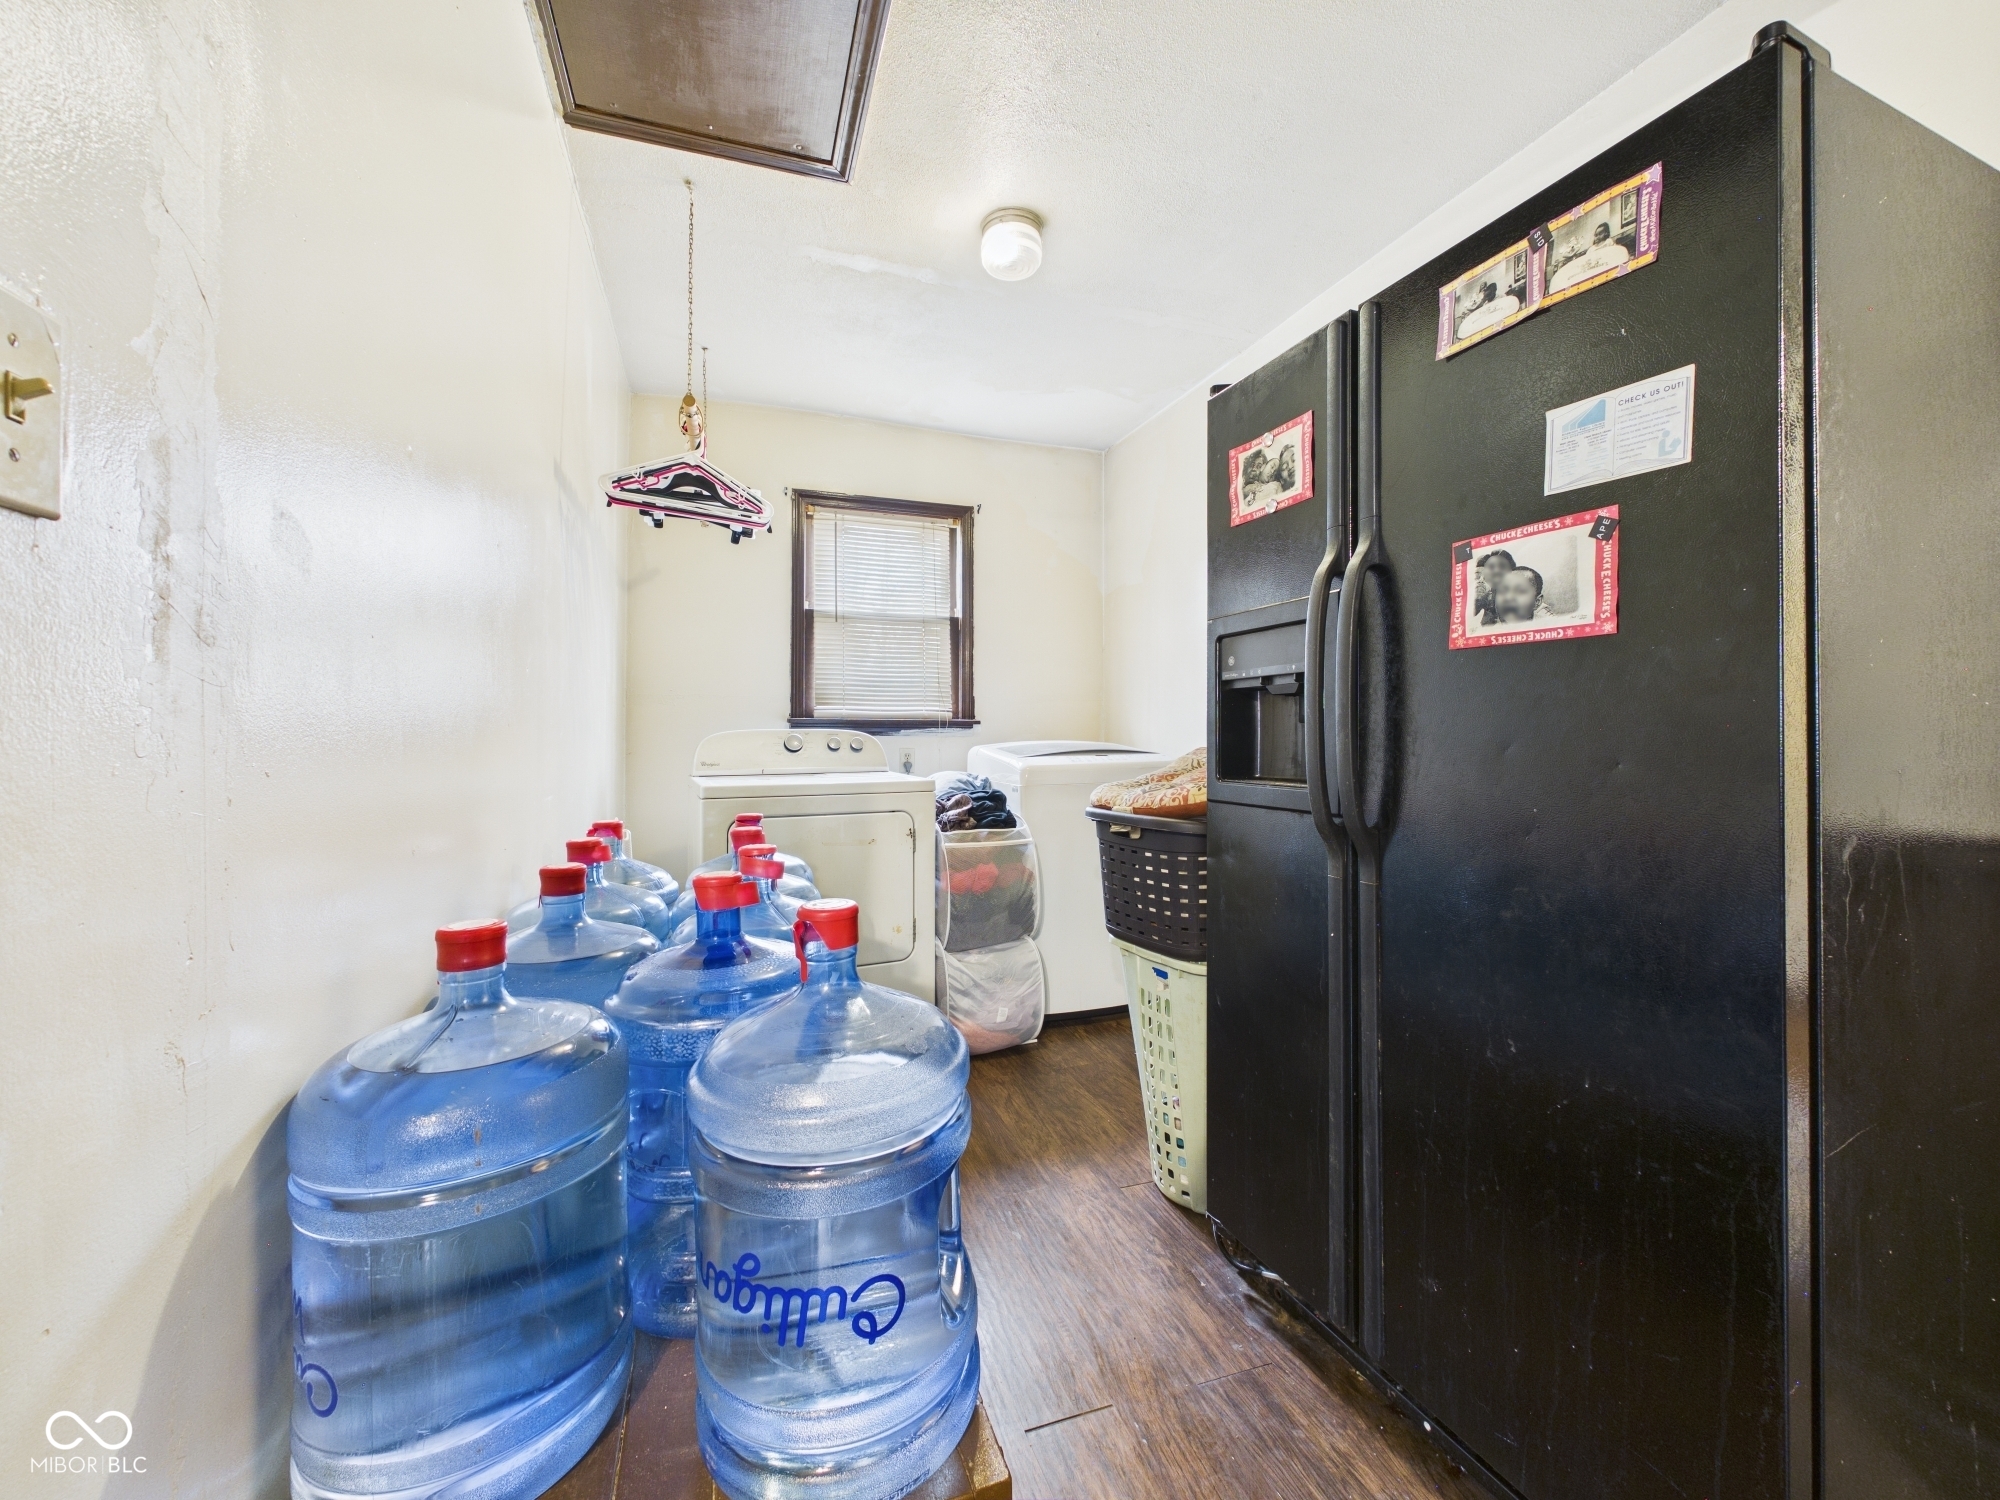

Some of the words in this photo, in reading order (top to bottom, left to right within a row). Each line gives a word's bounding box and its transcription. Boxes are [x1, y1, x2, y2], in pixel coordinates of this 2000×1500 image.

[1618, 393, 1647, 406] CHECK
[1664, 381, 1684, 392] OUT!
[1490, 530, 1517, 543] CHUCK
[1523, 519, 1561, 535] CHEESE'S
[1596, 518, 1611, 540] APE
[1454, 597, 1462, 623] CHUCK
[1600, 578, 1612, 618] CHEESE'S
[1491, 634, 1527, 645] CHEESE'S
[1535, 629, 1564, 640] CHUCK
[700, 1252, 906, 1347] Culligan
